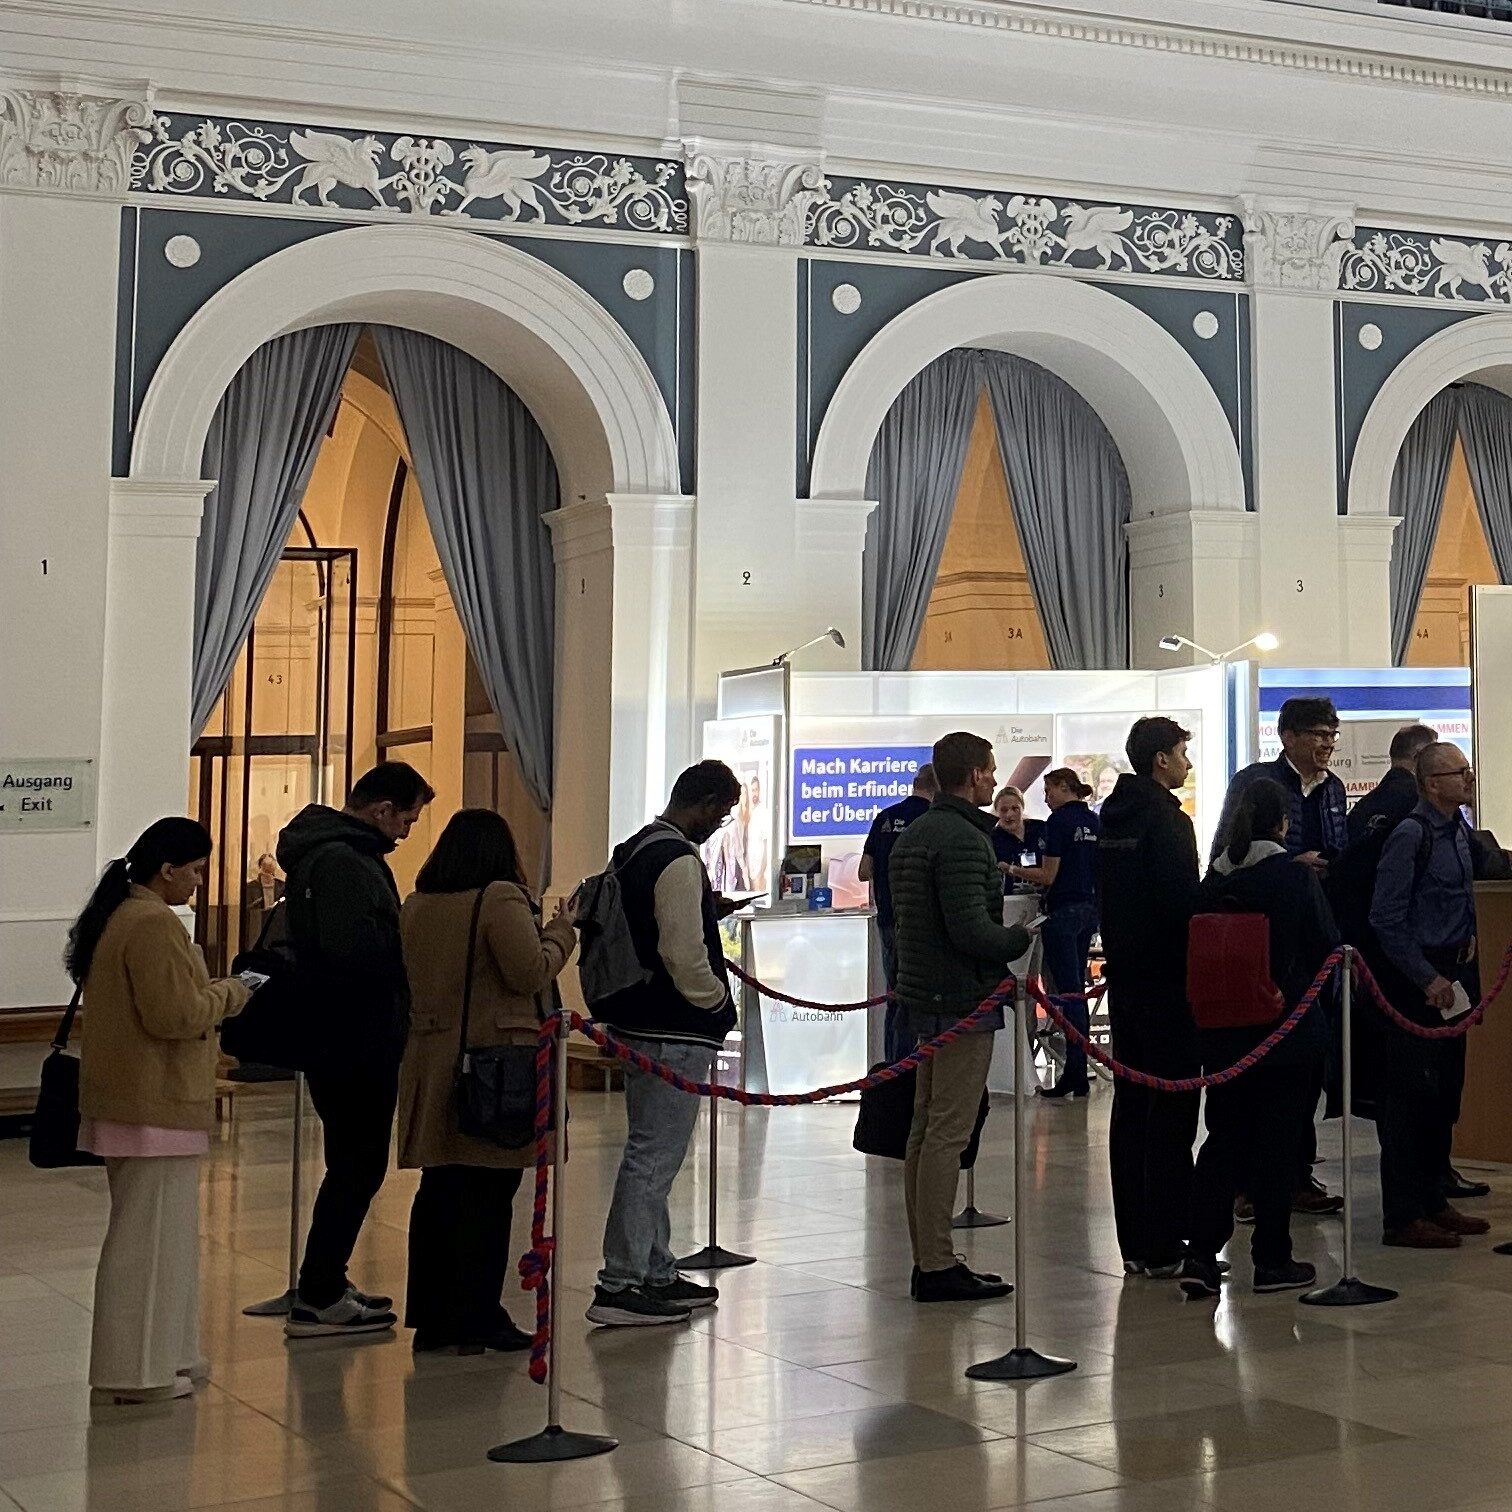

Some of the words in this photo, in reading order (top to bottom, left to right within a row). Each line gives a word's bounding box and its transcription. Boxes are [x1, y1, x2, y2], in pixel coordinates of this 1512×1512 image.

[41, 559, 47, 575] 1
[743, 571, 751, 585] 2
[1296, 579, 1304, 593] 3
[801, 758, 846, 775] Mach
[850, 757, 918, 774] Karriere
[3, 774, 73, 791] Ausgang
[801, 781, 844, 799] beim
[21, 797, 53, 811] Exit
[800, 807, 830, 823] der
